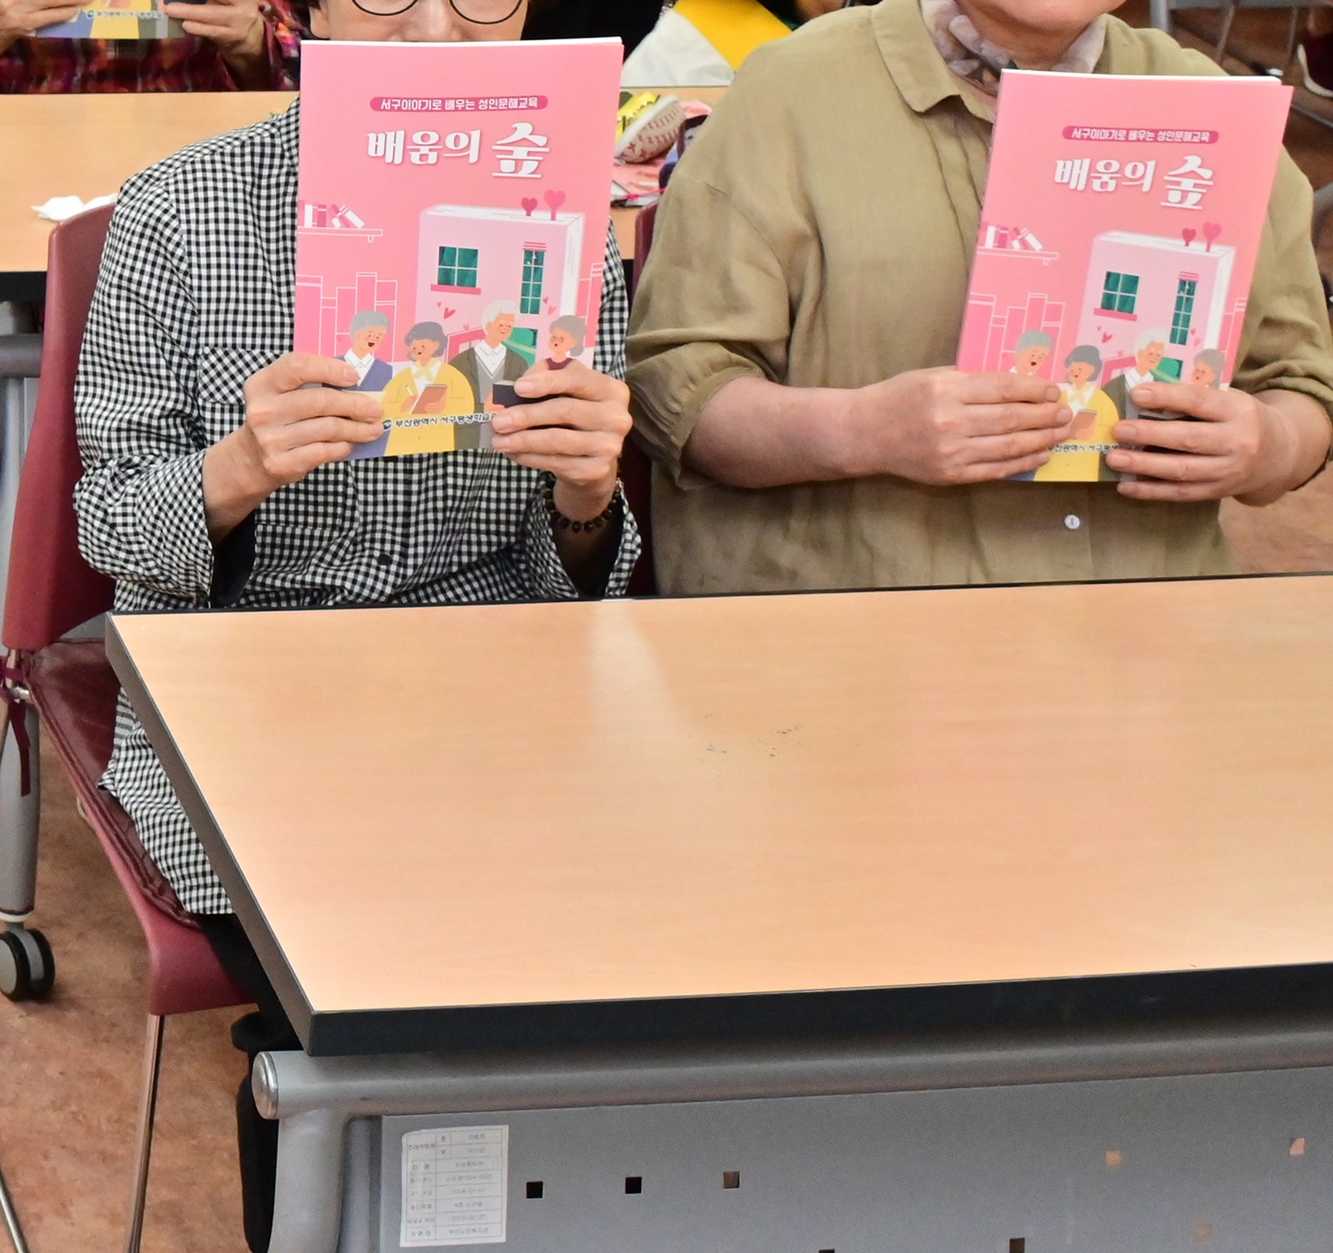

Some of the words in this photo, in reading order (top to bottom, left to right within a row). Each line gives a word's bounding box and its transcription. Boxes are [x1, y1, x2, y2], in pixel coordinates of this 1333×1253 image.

[381, 99, 442, 111] 서구이야기로
[445, 100, 475, 110] 배우는
[478, 97, 538, 110] 성인문해교육
[366, 129, 481, 165] 배움의
[491, 122, 550, 178] 숲
[1071, 128, 1126, 140] 서구이야기로
[1128, 130, 1155, 141] 배우는
[1157, 130, 1210, 143] 성인문해교육
[1054, 158, 1156, 193] 배움의
[1160, 155, 1214, 210] 숲
